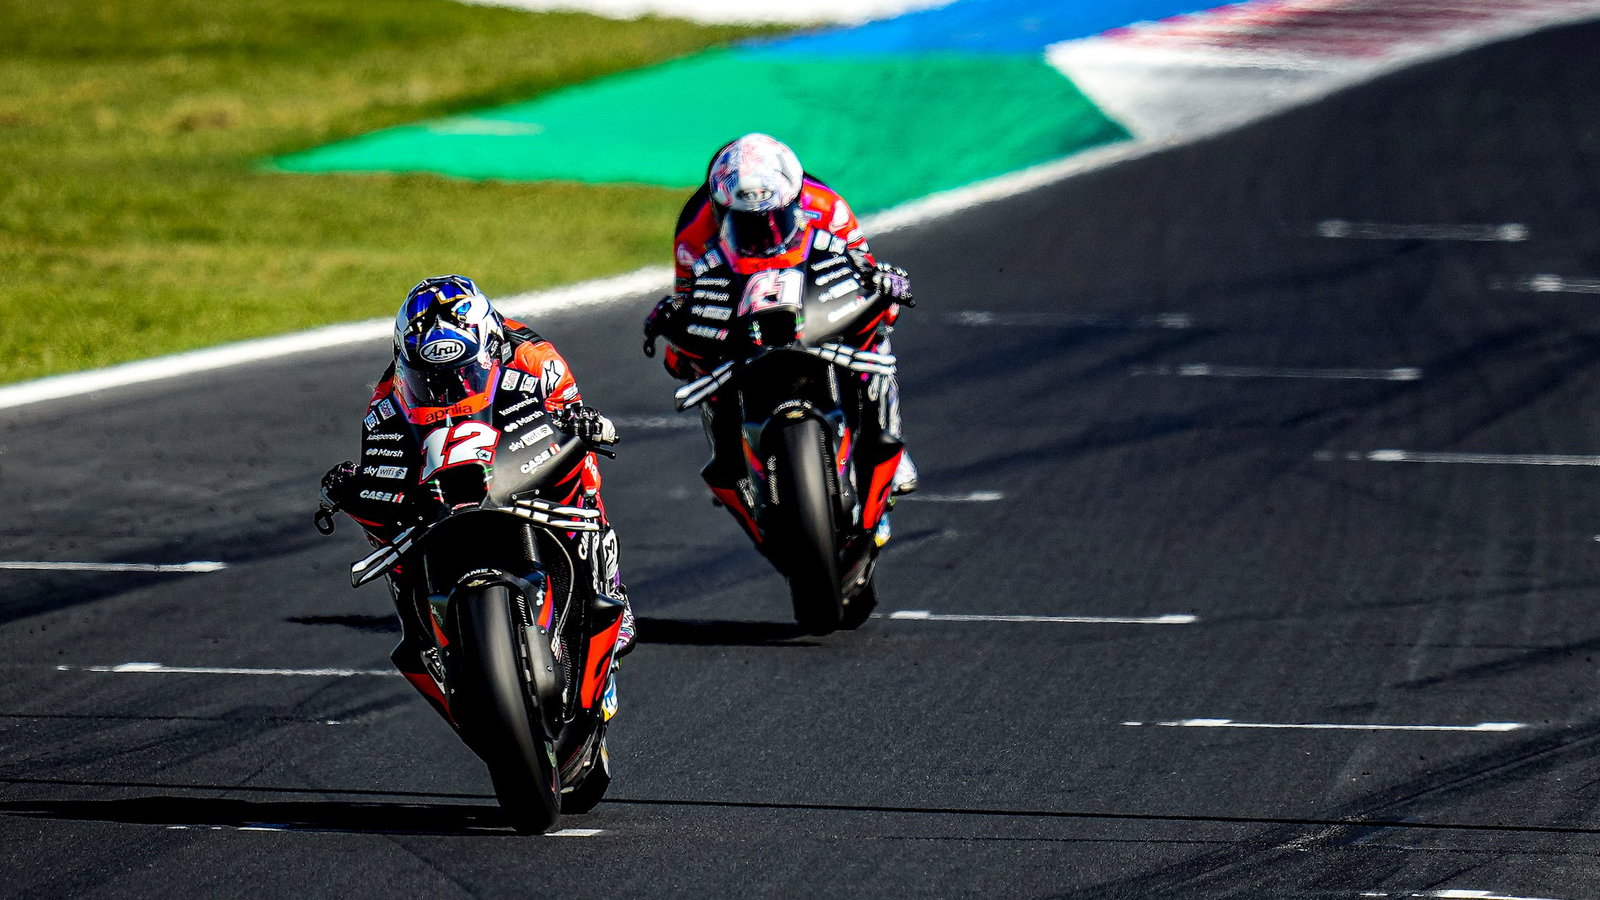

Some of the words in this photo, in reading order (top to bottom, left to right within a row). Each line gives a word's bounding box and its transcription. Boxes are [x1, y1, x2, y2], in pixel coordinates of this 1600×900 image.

[424, 342, 461, 358] Arai
[425, 402, 472, 422] aprilia
[516, 410, 544, 426] Marsh
[378, 448, 404, 457] Marsh
[419, 420, 501, 484] 12
[508, 440, 525, 452] sky
[520, 449, 551, 474] CASE
[363, 466, 378, 476] sky
[360, 489, 393, 502] CASE
